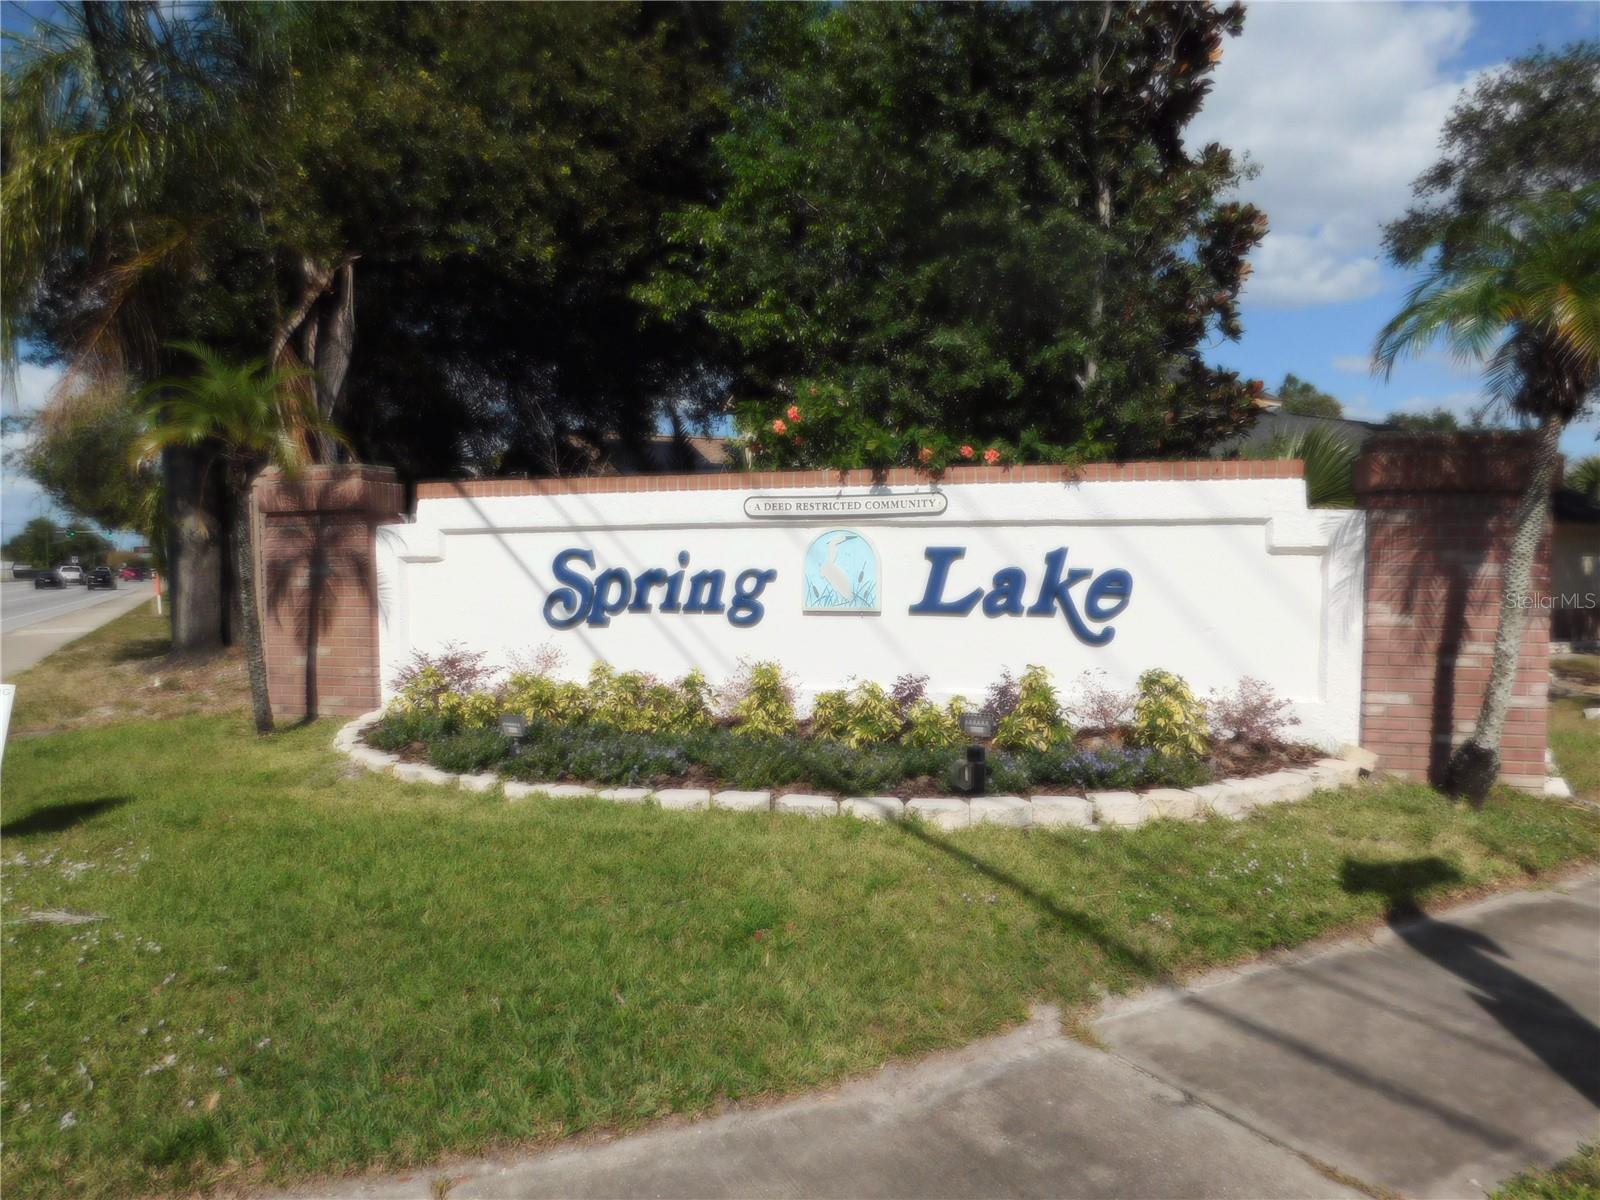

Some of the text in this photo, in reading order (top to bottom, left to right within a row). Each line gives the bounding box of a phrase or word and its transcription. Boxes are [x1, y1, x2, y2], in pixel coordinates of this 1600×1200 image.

[754, 498, 936, 511] A DEED RESTRICTED COMMUNITY
[543, 546, 1133, 647] Spring Lake
